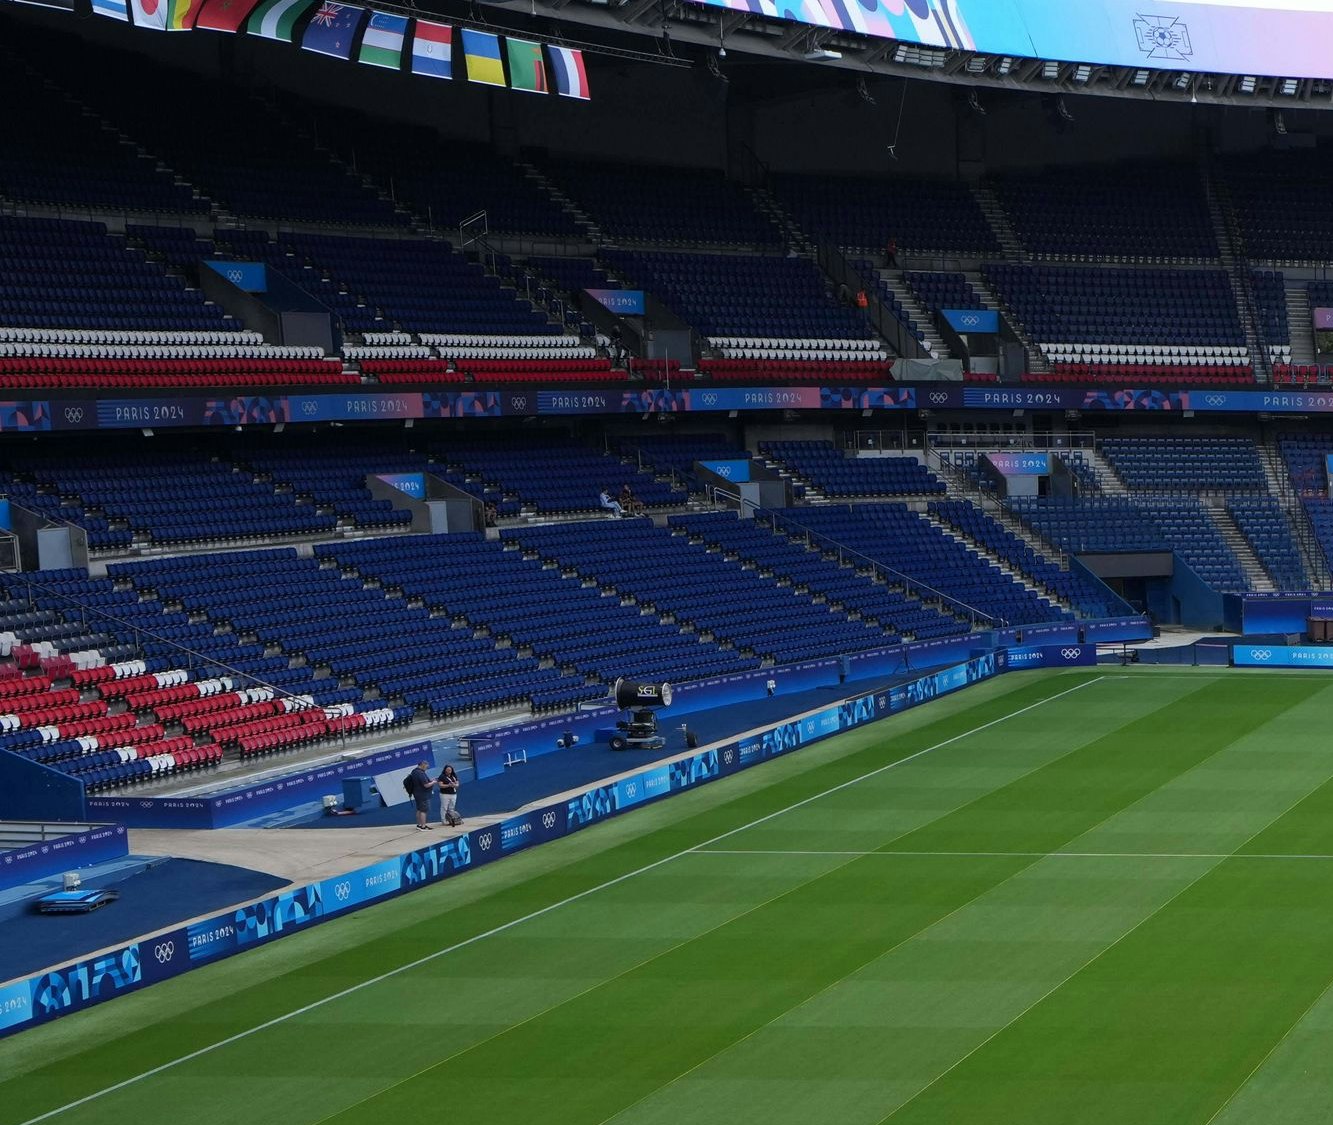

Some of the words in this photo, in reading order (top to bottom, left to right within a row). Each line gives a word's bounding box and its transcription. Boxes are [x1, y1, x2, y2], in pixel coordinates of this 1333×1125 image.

[745, 394, 772, 403] PARIS
[776, 394, 801, 403] 2024
[984, 393, 1022, 403] PARIS
[1027, 394, 1060, 404] 2024
[1264, 396, 1304, 406] PARIS
[348, 400, 378, 412] PARIS
[381, 400, 408, 412] 2024
[116, 407, 150, 420] PARIS
[154, 406, 184, 420] 2024
[192, 932, 213, 948] PARIS
[216, 926, 234, 940] 2024
